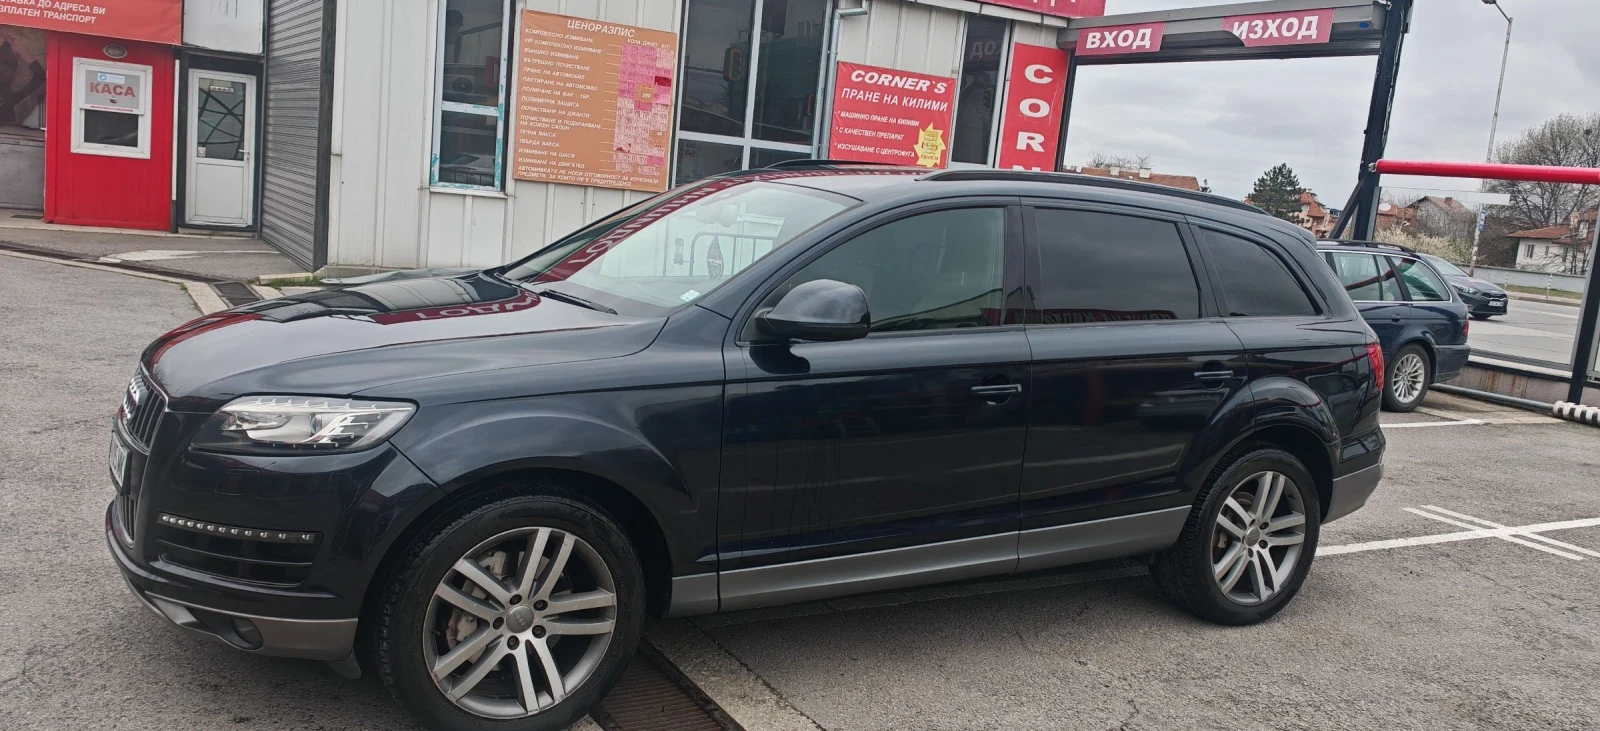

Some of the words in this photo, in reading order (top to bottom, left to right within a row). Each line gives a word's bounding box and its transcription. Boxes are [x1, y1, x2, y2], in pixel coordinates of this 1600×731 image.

[53, 2, 91, 13] АДРЕСА
[92, 6, 106, 15] ВИ
[43, 10, 96, 24] ТРАНСПОРТ
[567, 19, 635, 37] ЦЕНОРАЗПИС
[1232, 15, 1319, 40] ИЗХОД
[525, 28, 563, 39] КОМПЛЕКСНО
[564, 34, 594, 43] ИЗМИВАНЕ
[1086, 28, 1152, 49] ВХОД
[534, 39, 572, 50] КОМПЛЕКСНО
[573, 46, 602, 54] ИЗМИВАНЕ
[524, 48, 549, 56] ВЪНШНО
[550, 52, 580, 60] ИЗМИВАНЕ
[523, 58, 554, 66] ВЪТРЕШНО
[556, 62, 591, 72] ПОЧИСТВАНЕ
[523, 66, 542, 74] ПРАНЕ
[552, 72, 585, 80] АВТОМОБИЛ
[90, 82, 136, 97] КАСА
[522, 76, 554, 85] ПАСТИРАНЕ
[566, 82, 598, 91] АВТОМОБИЛ
[522, 86, 552, 94] ПОЛИРАНЕ
[521, 96, 555, 104] ПОЛИМЕРНА
[556, 100, 580, 108] ЗАЩИТА
[842, 88, 880, 102] ПРАНЕ
[883, 94, 898, 105] НА
[902, 96, 948, 112] КИЛИМИ
[520, 106, 556, 114] ПОЧИСТВАНЕ
[520, 114, 556, 124] ПОЧИСТВАНЕ
[840, 111, 870, 120] МАШИННО
[870, 115, 888, 123] ПРАНЕ
[897, 118, 919, 126] КИЛИМИ
[844, 128, 876, 136] КАЧЕСТВЕН
[876, 132, 904, 140] ПРЕПАРАТ
[520, 138, 540, 146] ТВЪРДА
[518, 148, 548, 156] ИЗМИВАНЕ
[837, 143, 875, 153] ИЗСУШАВАНЕ
[880, 148, 914, 158] ЦЕНТРОФУГА
[518, 165, 557, 174] АВТОМИВКАТА
[584, 172, 621, 180] ОТГОВОРНОСТ
